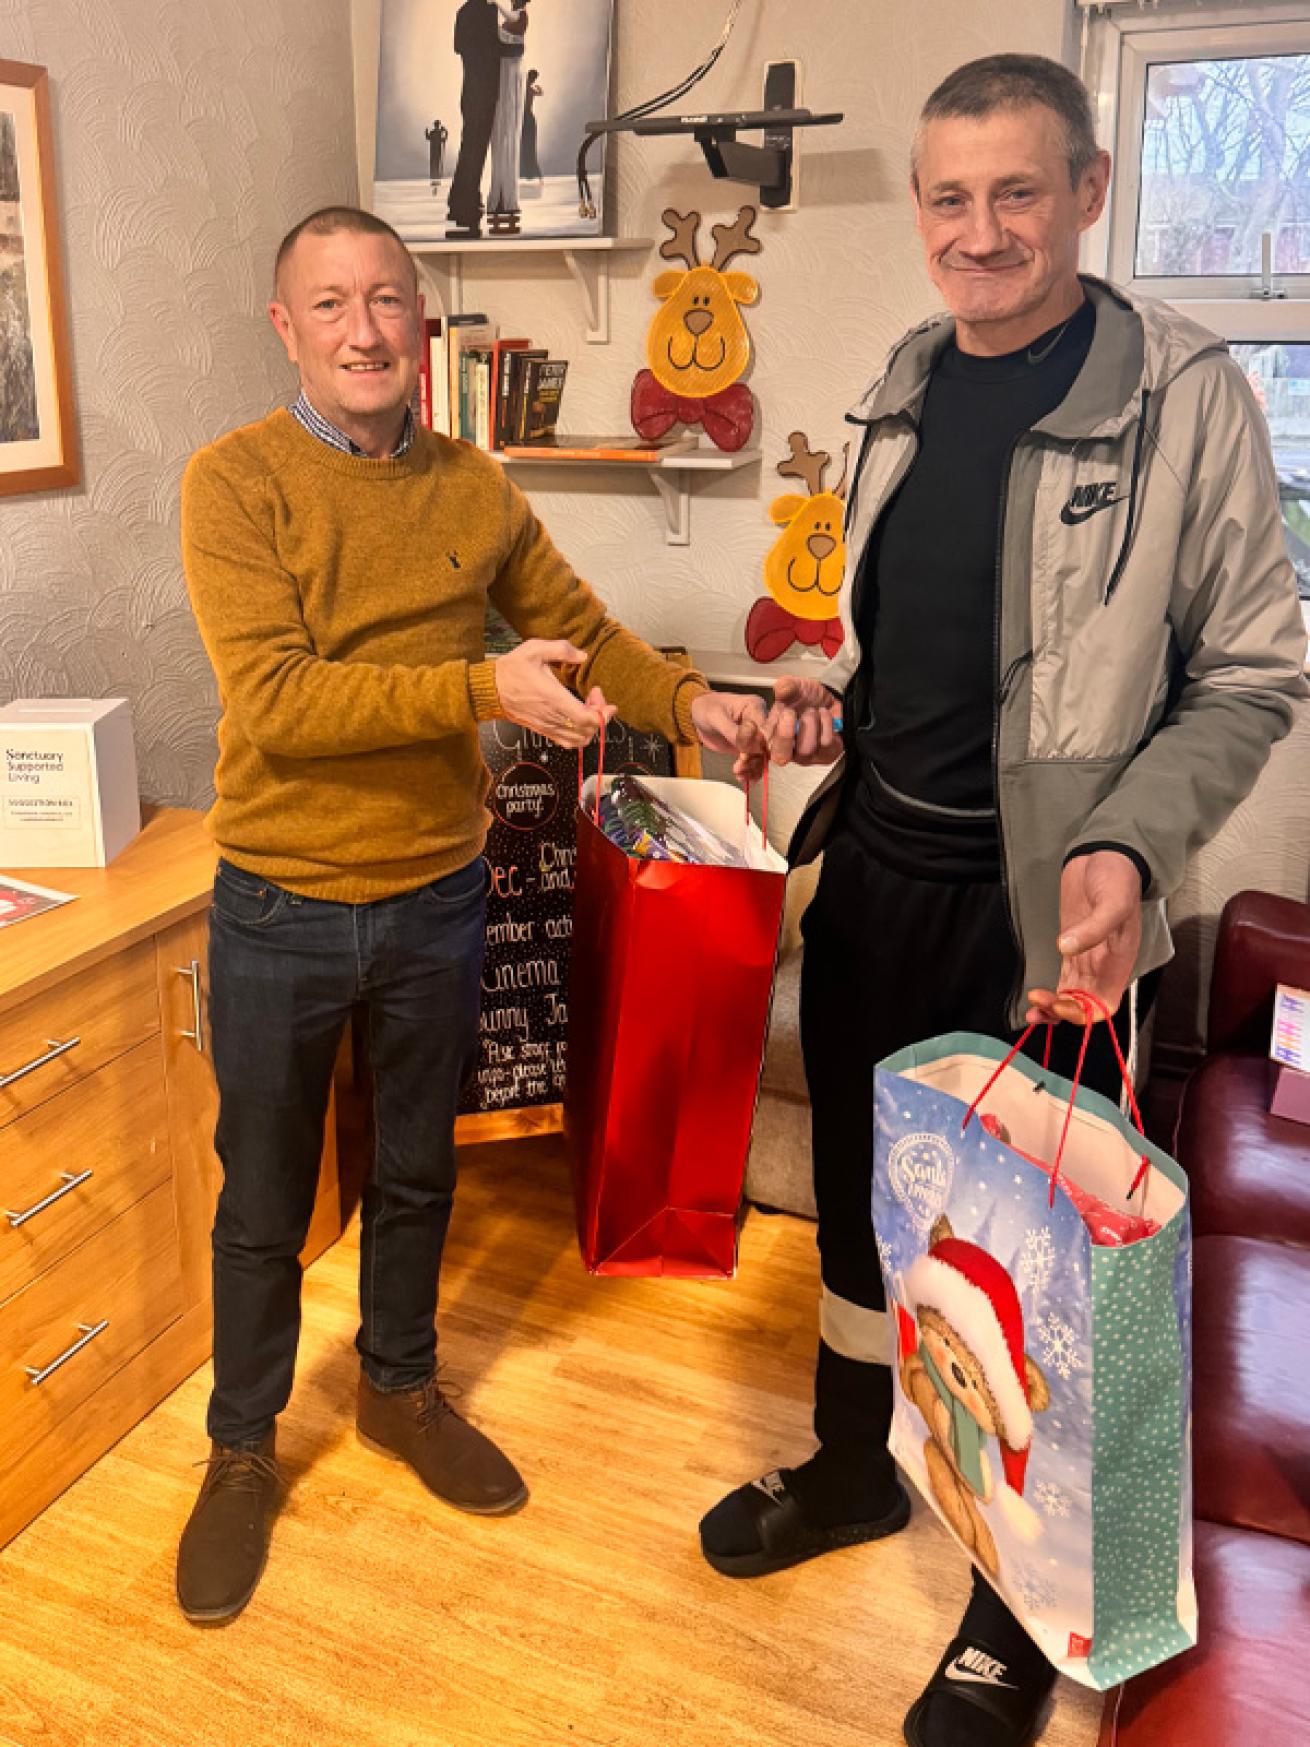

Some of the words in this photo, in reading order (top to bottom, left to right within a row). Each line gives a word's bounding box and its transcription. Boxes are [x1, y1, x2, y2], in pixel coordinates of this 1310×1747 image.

[1071, 482, 1117, 508] NIKE
[6, 749, 64, 763] Sanctuary
[7, 760, 64, 773] Supported
[8, 772, 40, 785] Living
[486, 912, 535, 946] ember
[480, 1006, 529, 1042] unny
[960, 1646, 1008, 1680] NIKE
